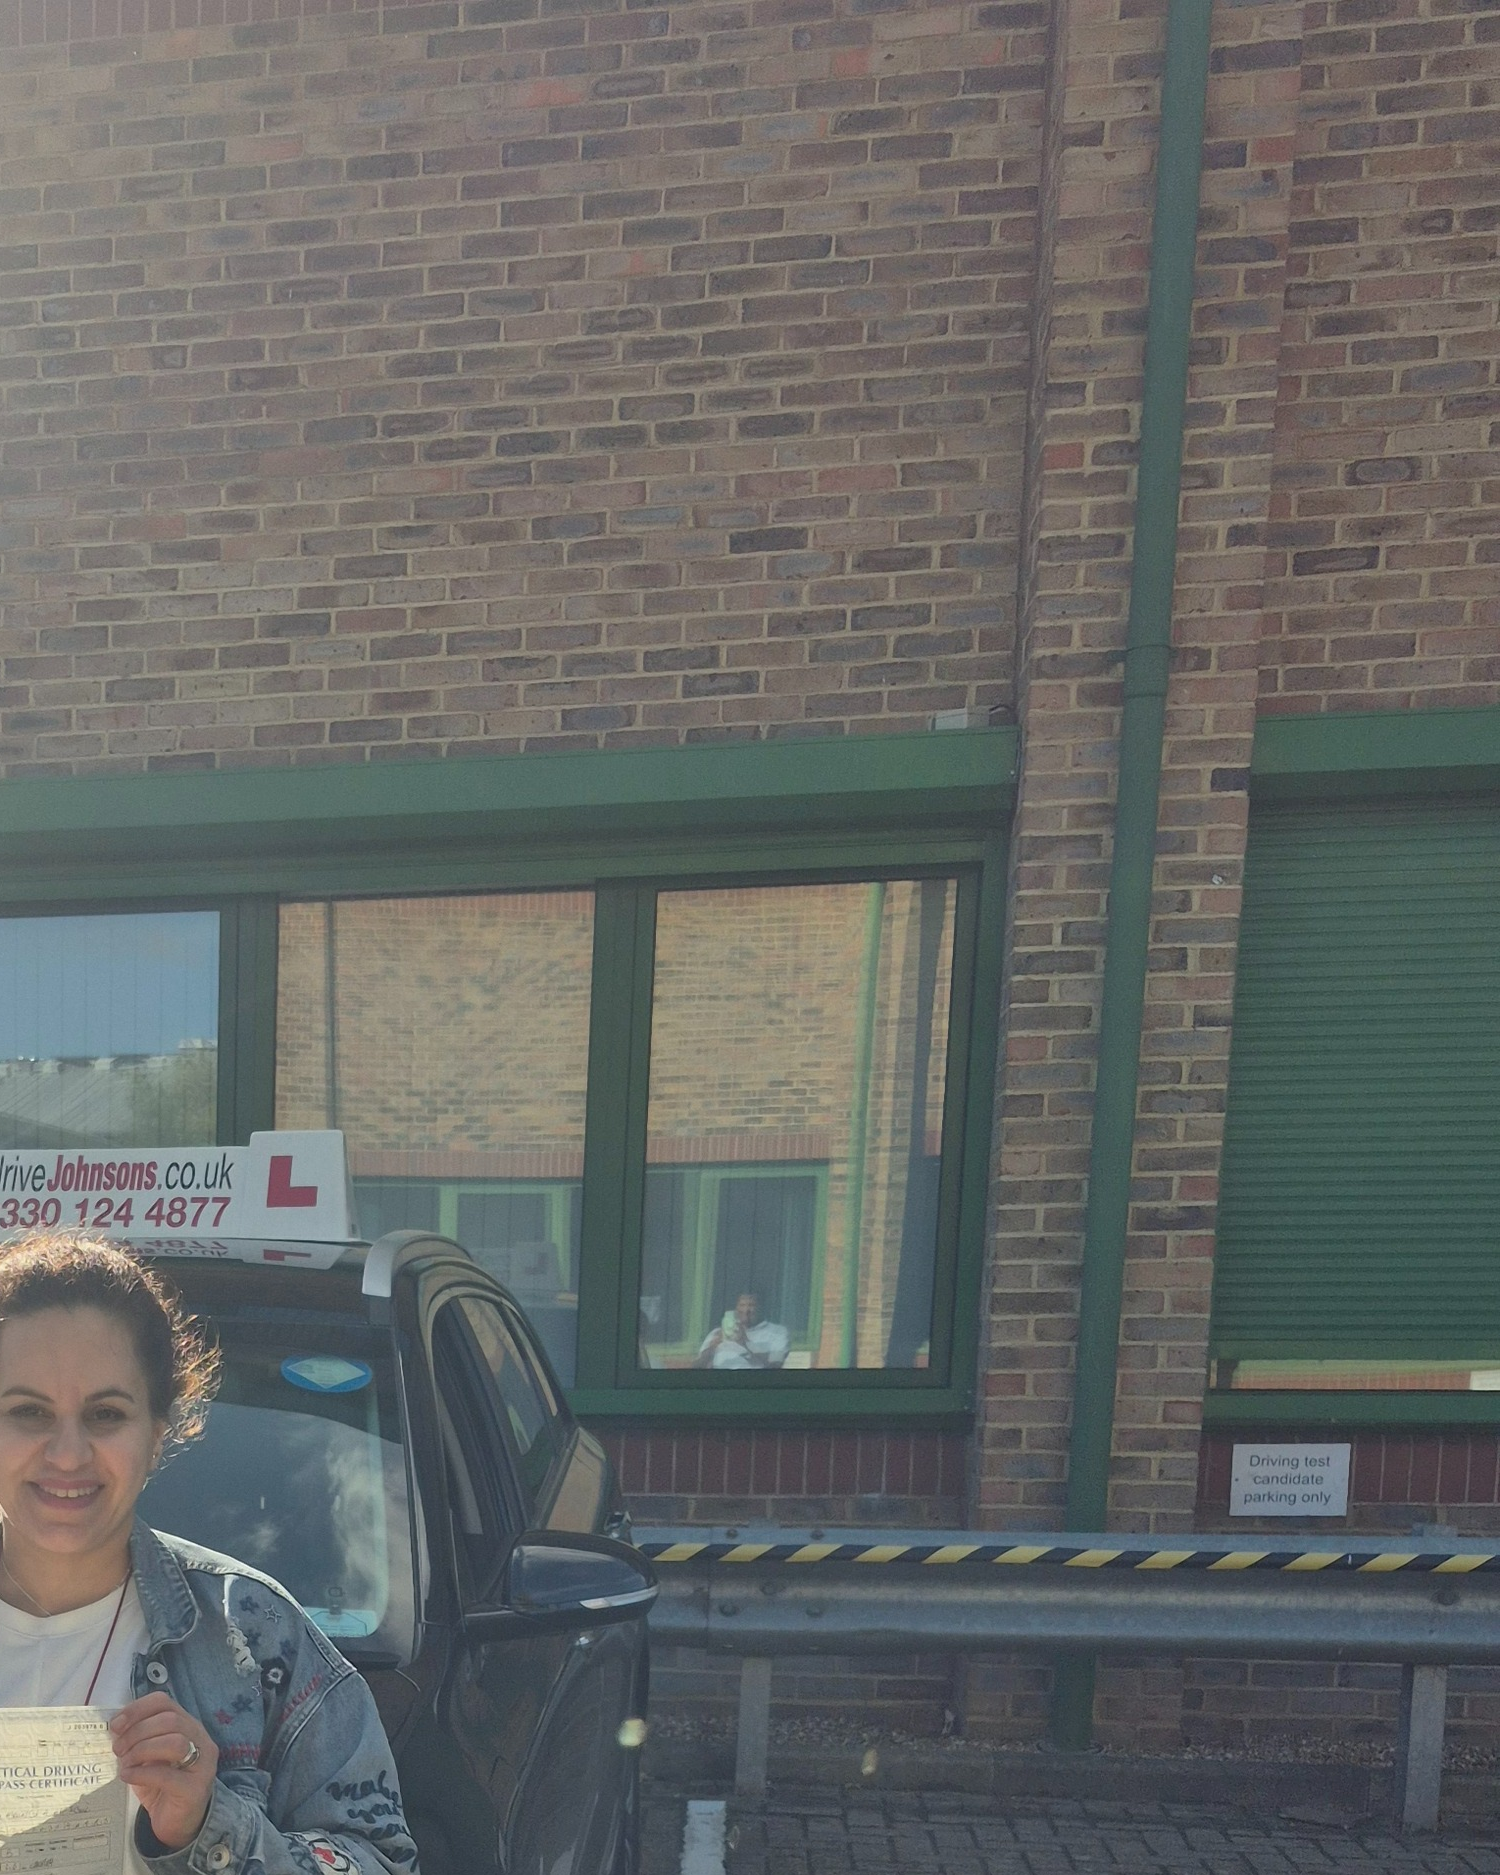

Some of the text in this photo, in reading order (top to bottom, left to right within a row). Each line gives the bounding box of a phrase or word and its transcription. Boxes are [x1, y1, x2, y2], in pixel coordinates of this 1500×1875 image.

[266, 1155, 318, 1208] L
[75, 1198, 133, 1229] 124
[144, 1197, 231, 1228] 4877
[1250, 1455, 1331, 1470] Driving test
[1253, 1473, 1324, 1485] candidate
[1244, 1491, 1331, 1505] parking only
[43, 1763, 102, 1777] DRIVING
[29, 1775, 101, 1790] CERTIFICATE
